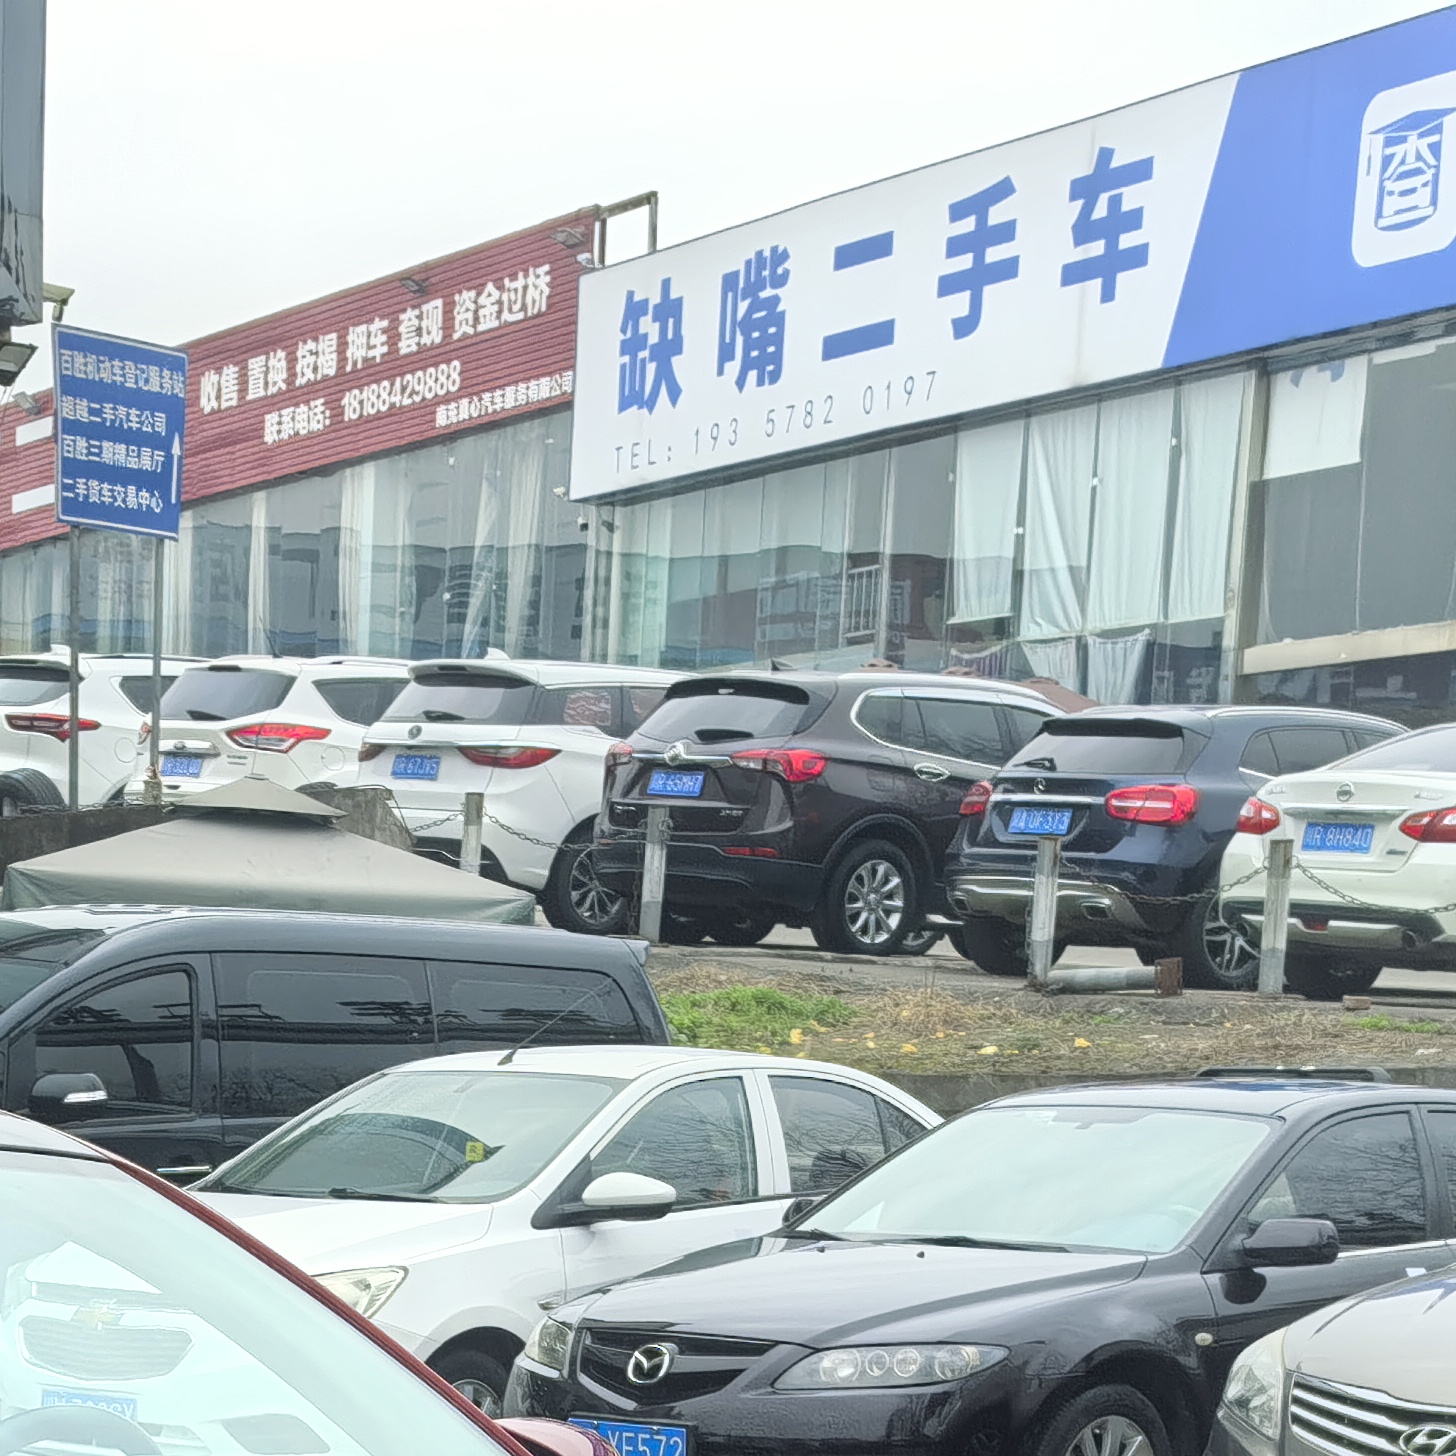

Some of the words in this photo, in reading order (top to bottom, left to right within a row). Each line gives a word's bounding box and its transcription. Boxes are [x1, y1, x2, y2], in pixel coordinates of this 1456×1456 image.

[617, 146, 1154, 416] 缺嘴二手车
[200, 366, 239, 414] 收售
[246, 349, 287, 402] 置换
[295, 333, 338, 387] 按揭
[345, 318, 389, 372] 押车
[397, 298, 443, 357] 套现
[452, 264, 551, 340] 资金过桥
[59, 349, 185, 398] 百胜机动车登记服务站
[341, 360, 461, 422] 18188429888
[61, 395, 167, 436] 超越二手汽车公司
[693, 416, 739, 457] 193
[765, 395, 834, 439] 5782
[862, 370, 938, 416] 0197
[62, 434, 165, 473] 百胜三期精品展厅
[62, 478, 163, 513] 二手货车交易中心
